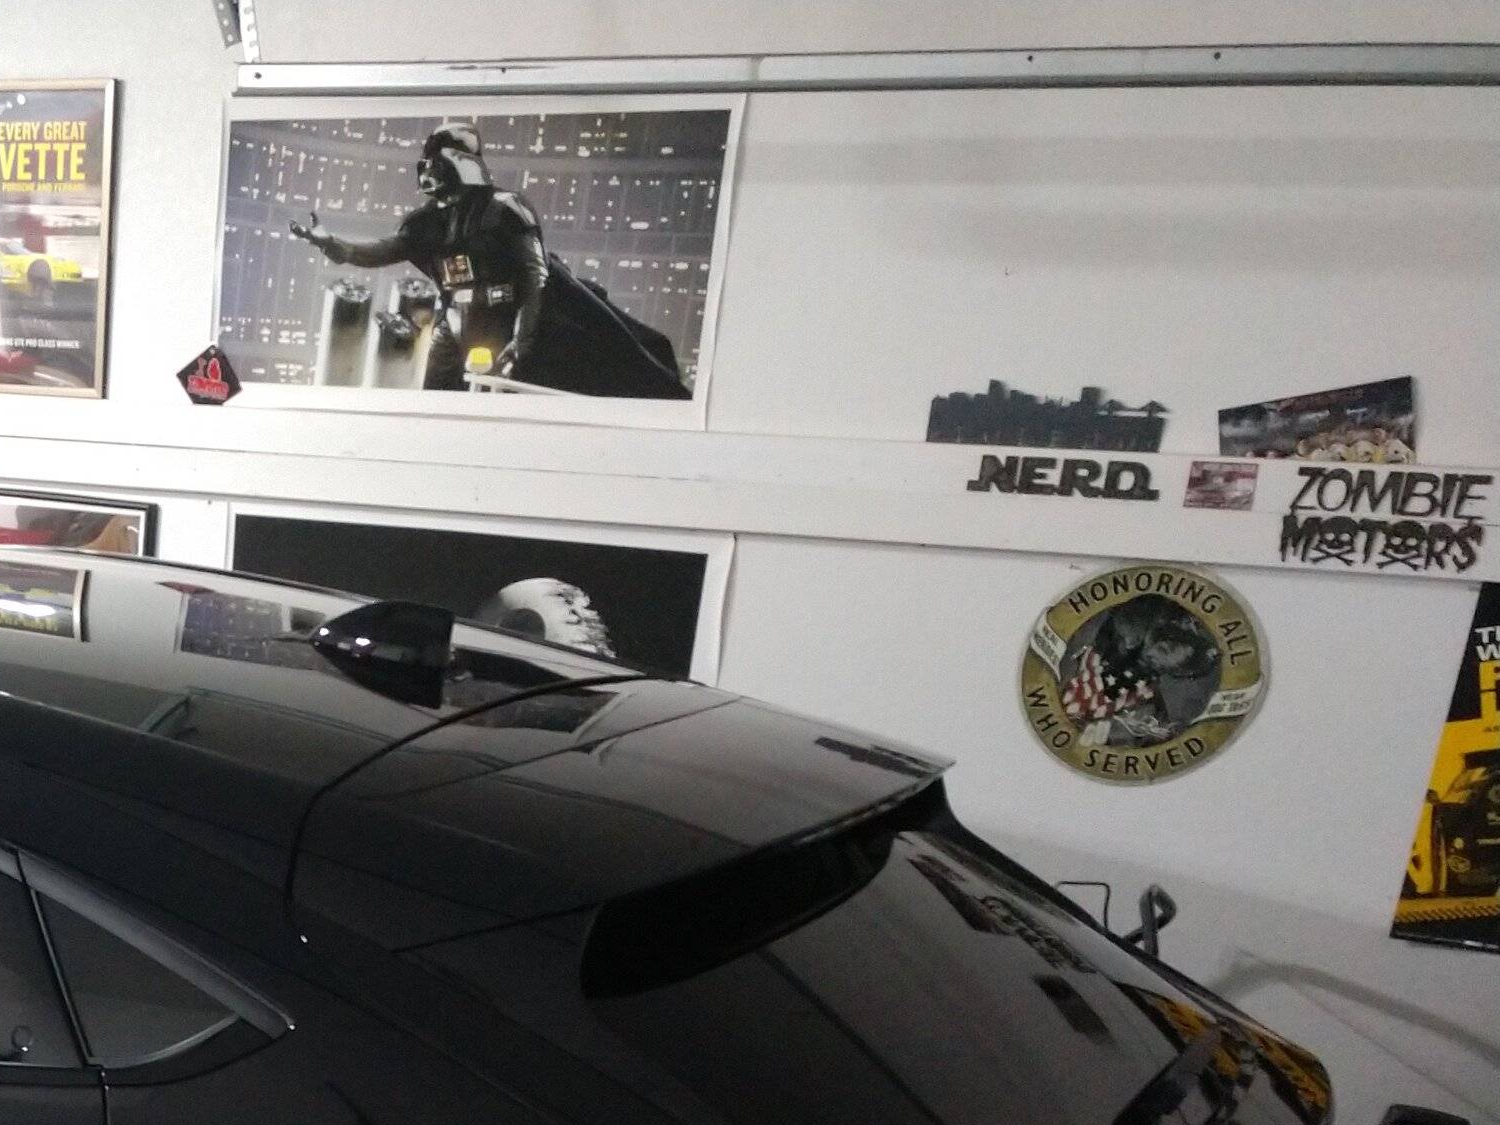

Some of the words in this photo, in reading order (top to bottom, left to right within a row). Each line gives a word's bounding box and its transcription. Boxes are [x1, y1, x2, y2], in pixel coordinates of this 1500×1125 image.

[43, 120, 88, 141] GREAT
[966, 454, 1160, 502] NERD
[1289, 466, 1496, 521] ZOMBIE
[1279, 511, 1485, 573] MOTORS
[1068, 572, 1222, 615] HONORING
[1218, 619, 1253, 666] ALL
[1026, 686, 1071, 749] WHO
[1084, 737, 1205, 775] SERVED
